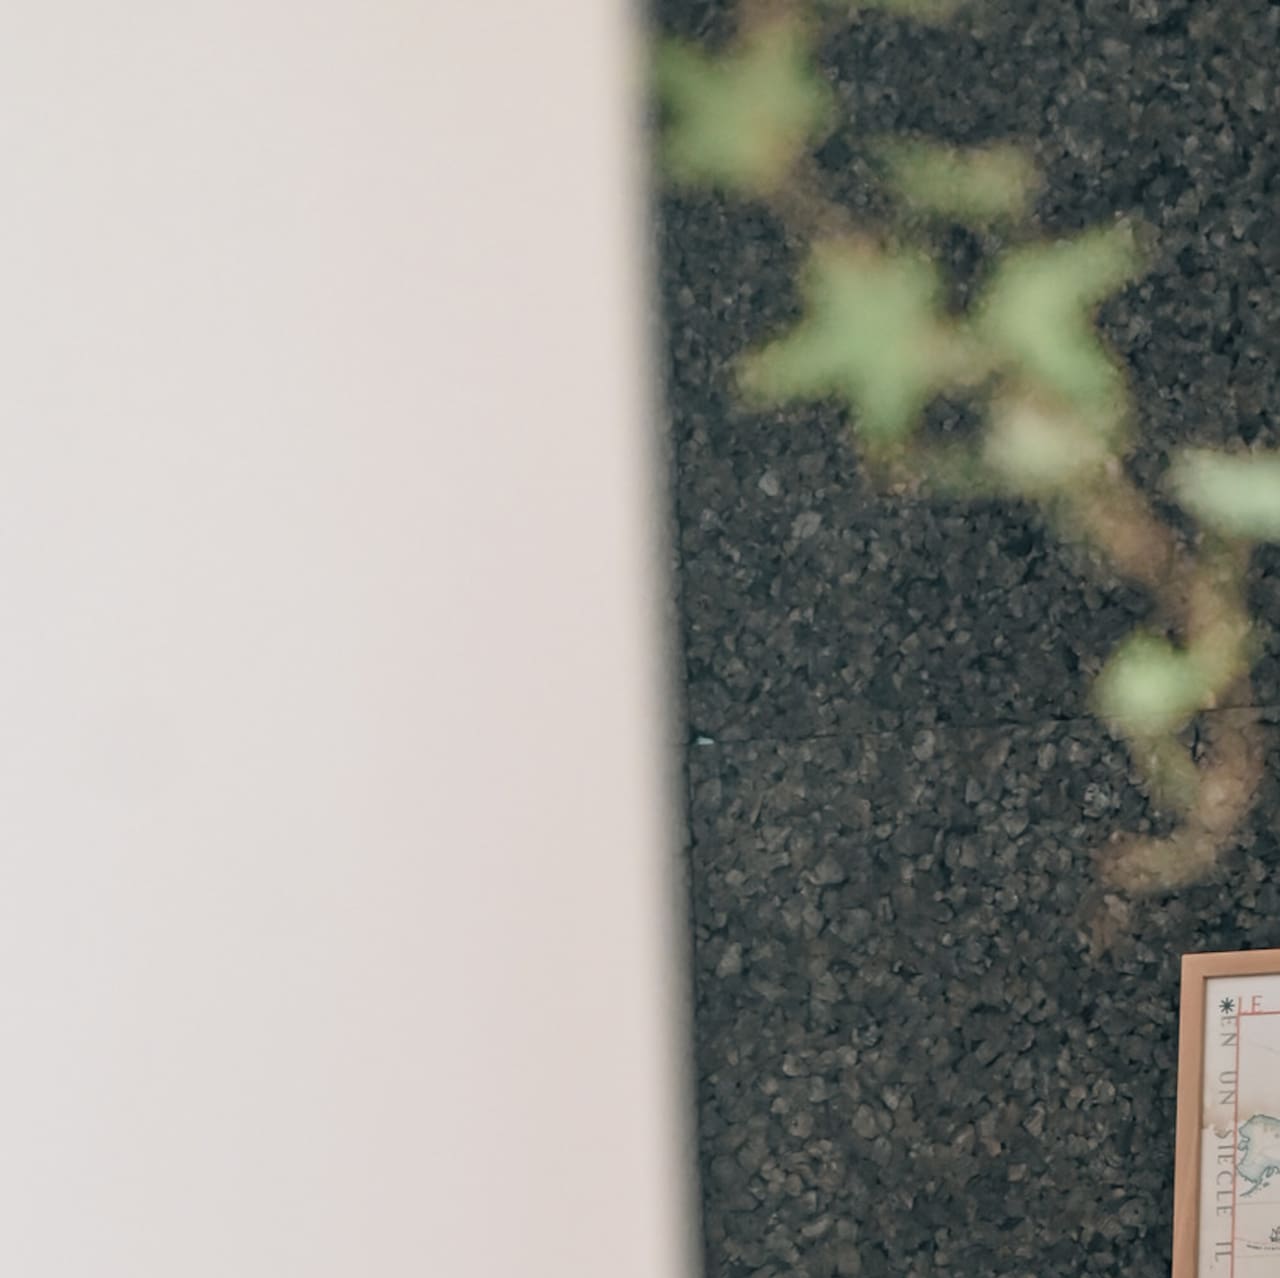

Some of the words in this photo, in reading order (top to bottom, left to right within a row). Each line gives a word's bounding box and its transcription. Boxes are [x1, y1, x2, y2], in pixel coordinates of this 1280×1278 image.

[1237, 995, 1263, 1014] LE
[1220, 1015, 1238, 1047] EN
[1218, 1070, 1237, 1105] UN
[1214, 1240, 1232, 1263] IL
